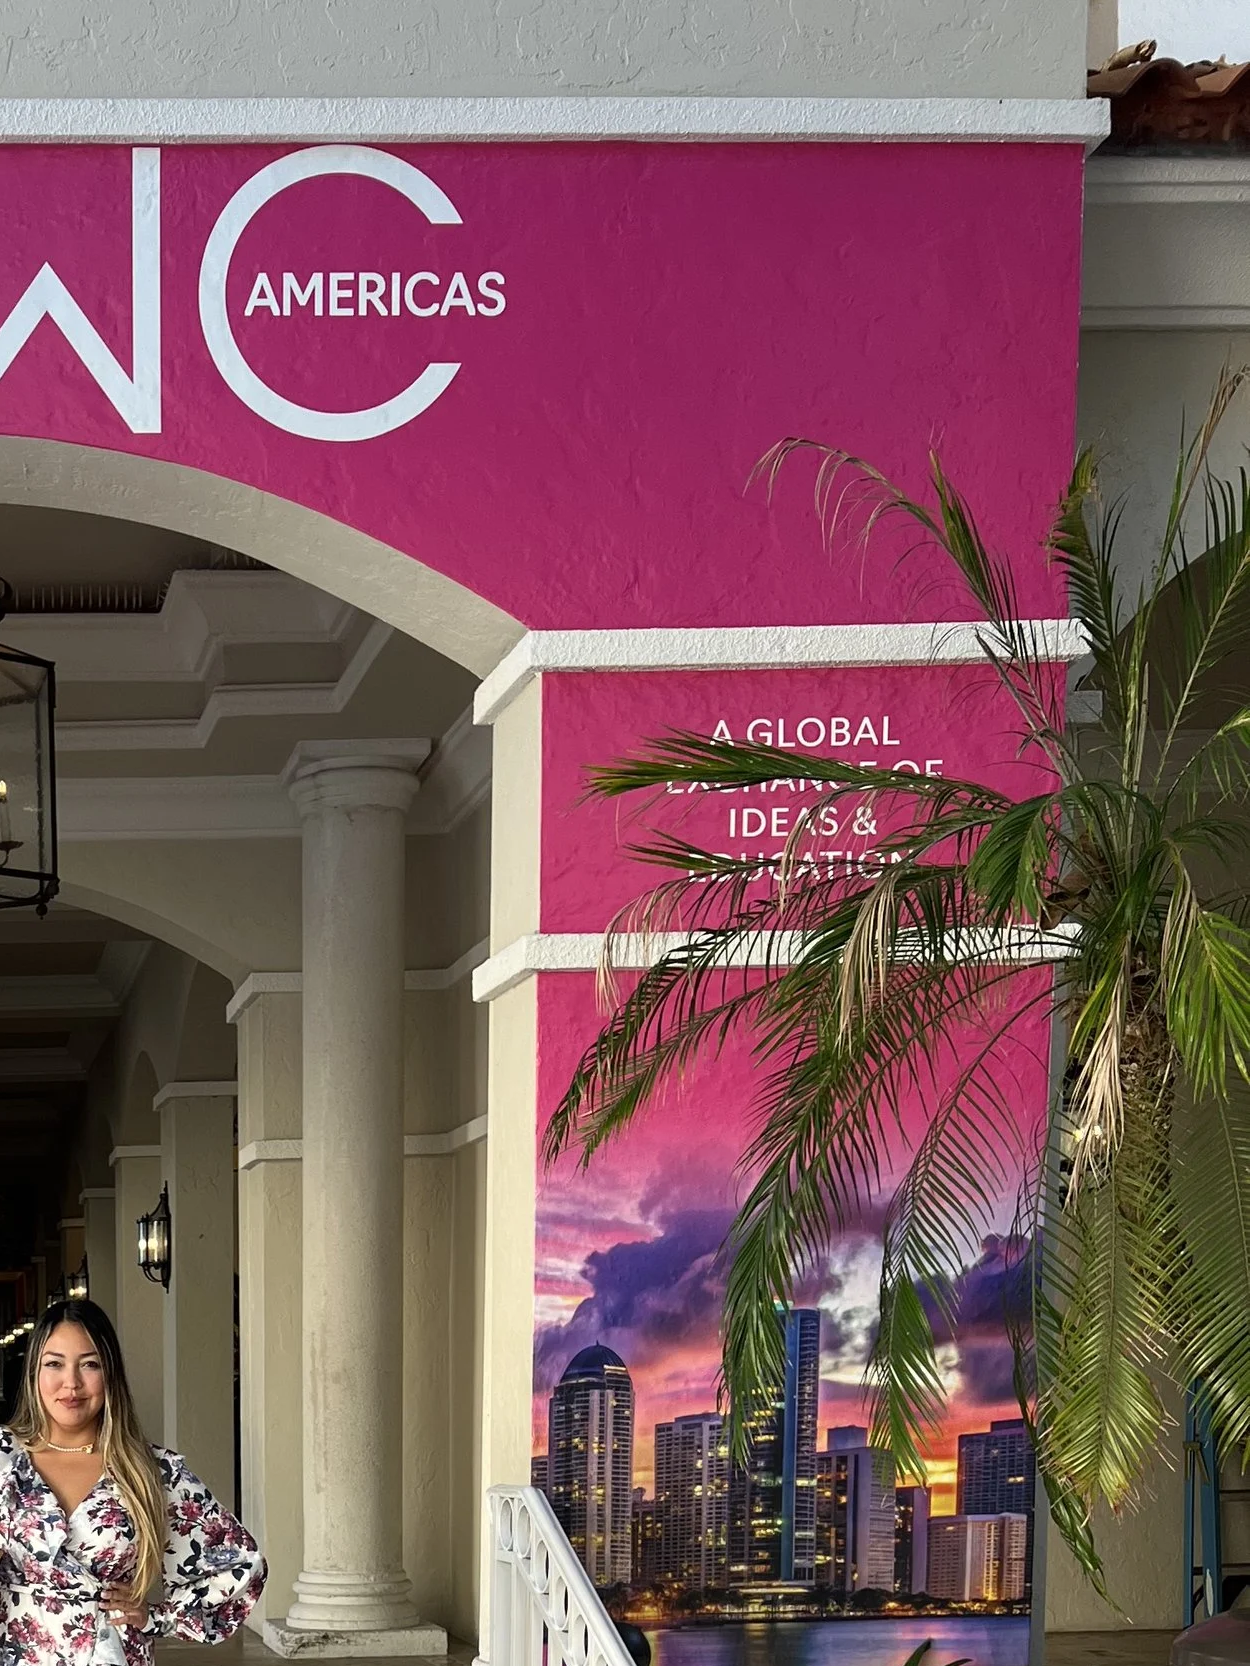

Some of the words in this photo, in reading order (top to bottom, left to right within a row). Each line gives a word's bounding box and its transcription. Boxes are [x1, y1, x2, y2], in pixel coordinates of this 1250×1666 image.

[244, 270, 507, 318] AMERICAS
[710, 719, 735, 747] A
[746, 715, 900, 748] GLOBAL
[852, 806, 877, 836] &
